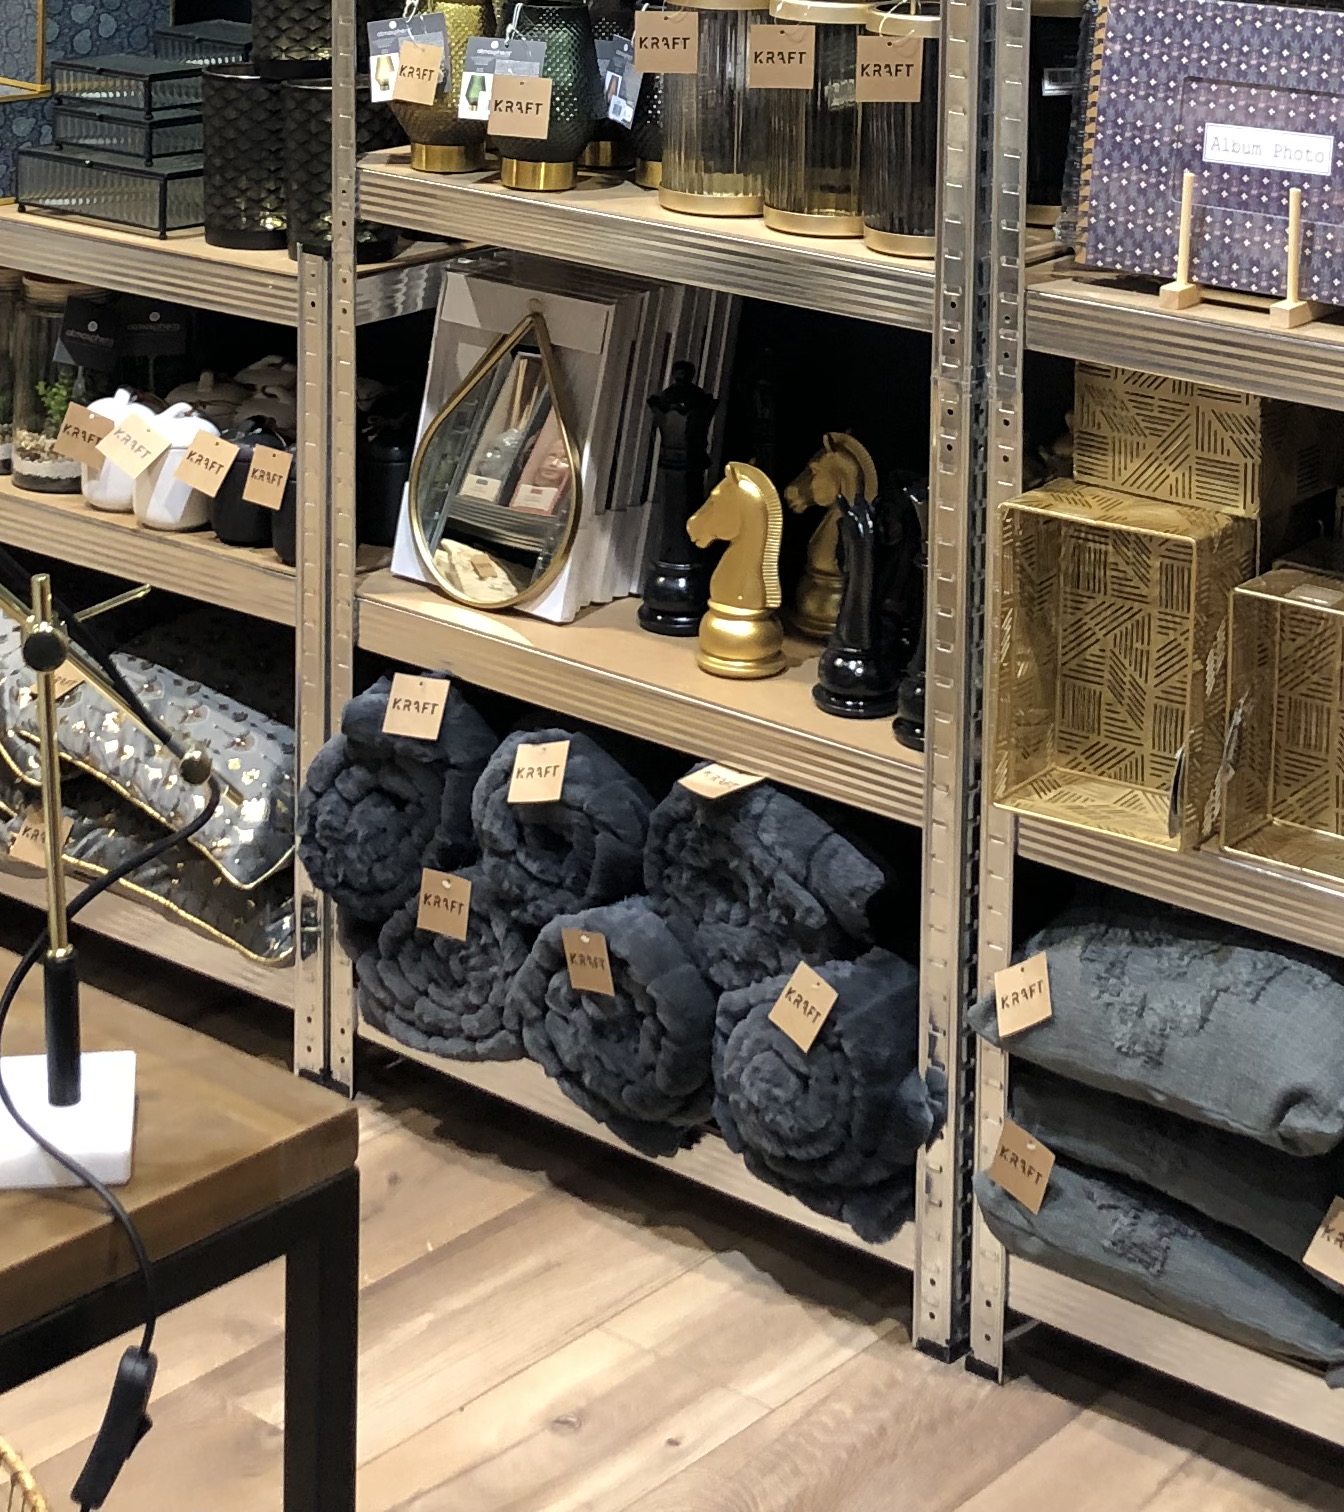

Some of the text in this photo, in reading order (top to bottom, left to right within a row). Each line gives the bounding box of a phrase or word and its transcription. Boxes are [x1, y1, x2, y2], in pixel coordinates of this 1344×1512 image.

[638, 36, 690, 50] KRAFT
[754, 51, 807, 65] KRAFT
[398, 64, 434, 82] KRAFT
[860, 63, 914, 78] KRAFT
[494, 100, 544, 116] KRAFT
[1210, 136, 1325, 164] Album Photo
[114, 427, 152, 460] KRAFT
[186, 451, 225, 475] KRAFT
[250, 468, 284, 487] KRAFT
[392, 698, 440, 716] KRAFT
[516, 764, 560, 780] KRAFT
[702, 769, 739, 788] KRAFT
[423, 892, 464, 916] KRAFT
[569, 952, 606, 971] KRAFT
[1000, 980, 1044, 1010] KRAFT
[786, 988, 822, 1024] KRAFT
[999, 1146, 1044, 1186] KRAFT
